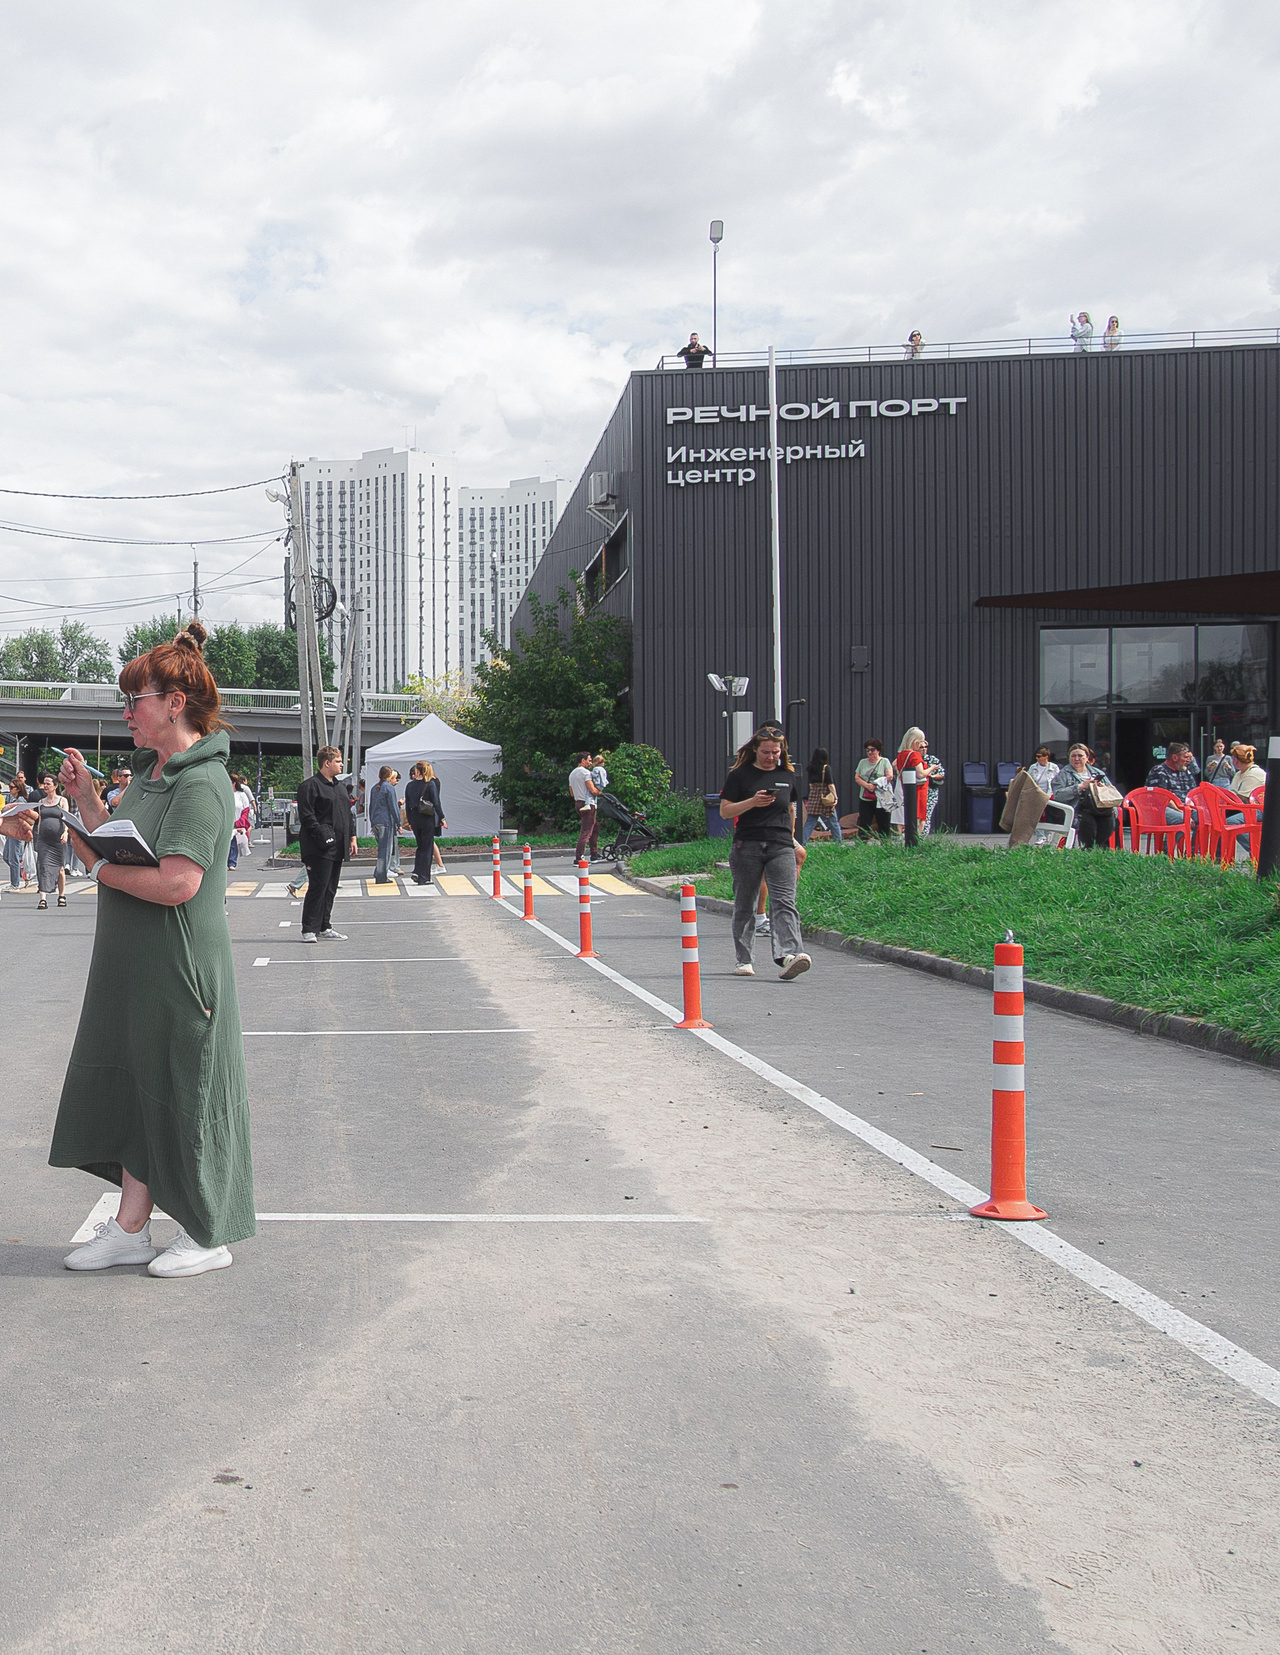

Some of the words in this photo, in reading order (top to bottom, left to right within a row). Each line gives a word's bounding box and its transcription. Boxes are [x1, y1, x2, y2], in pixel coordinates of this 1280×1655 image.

[666, 397, 841, 425] РЕЧНОЙ
[849, 397, 968, 418] ПОРТ
[666, 439, 866, 464] Инженерный
[666, 467, 756, 487] центр
